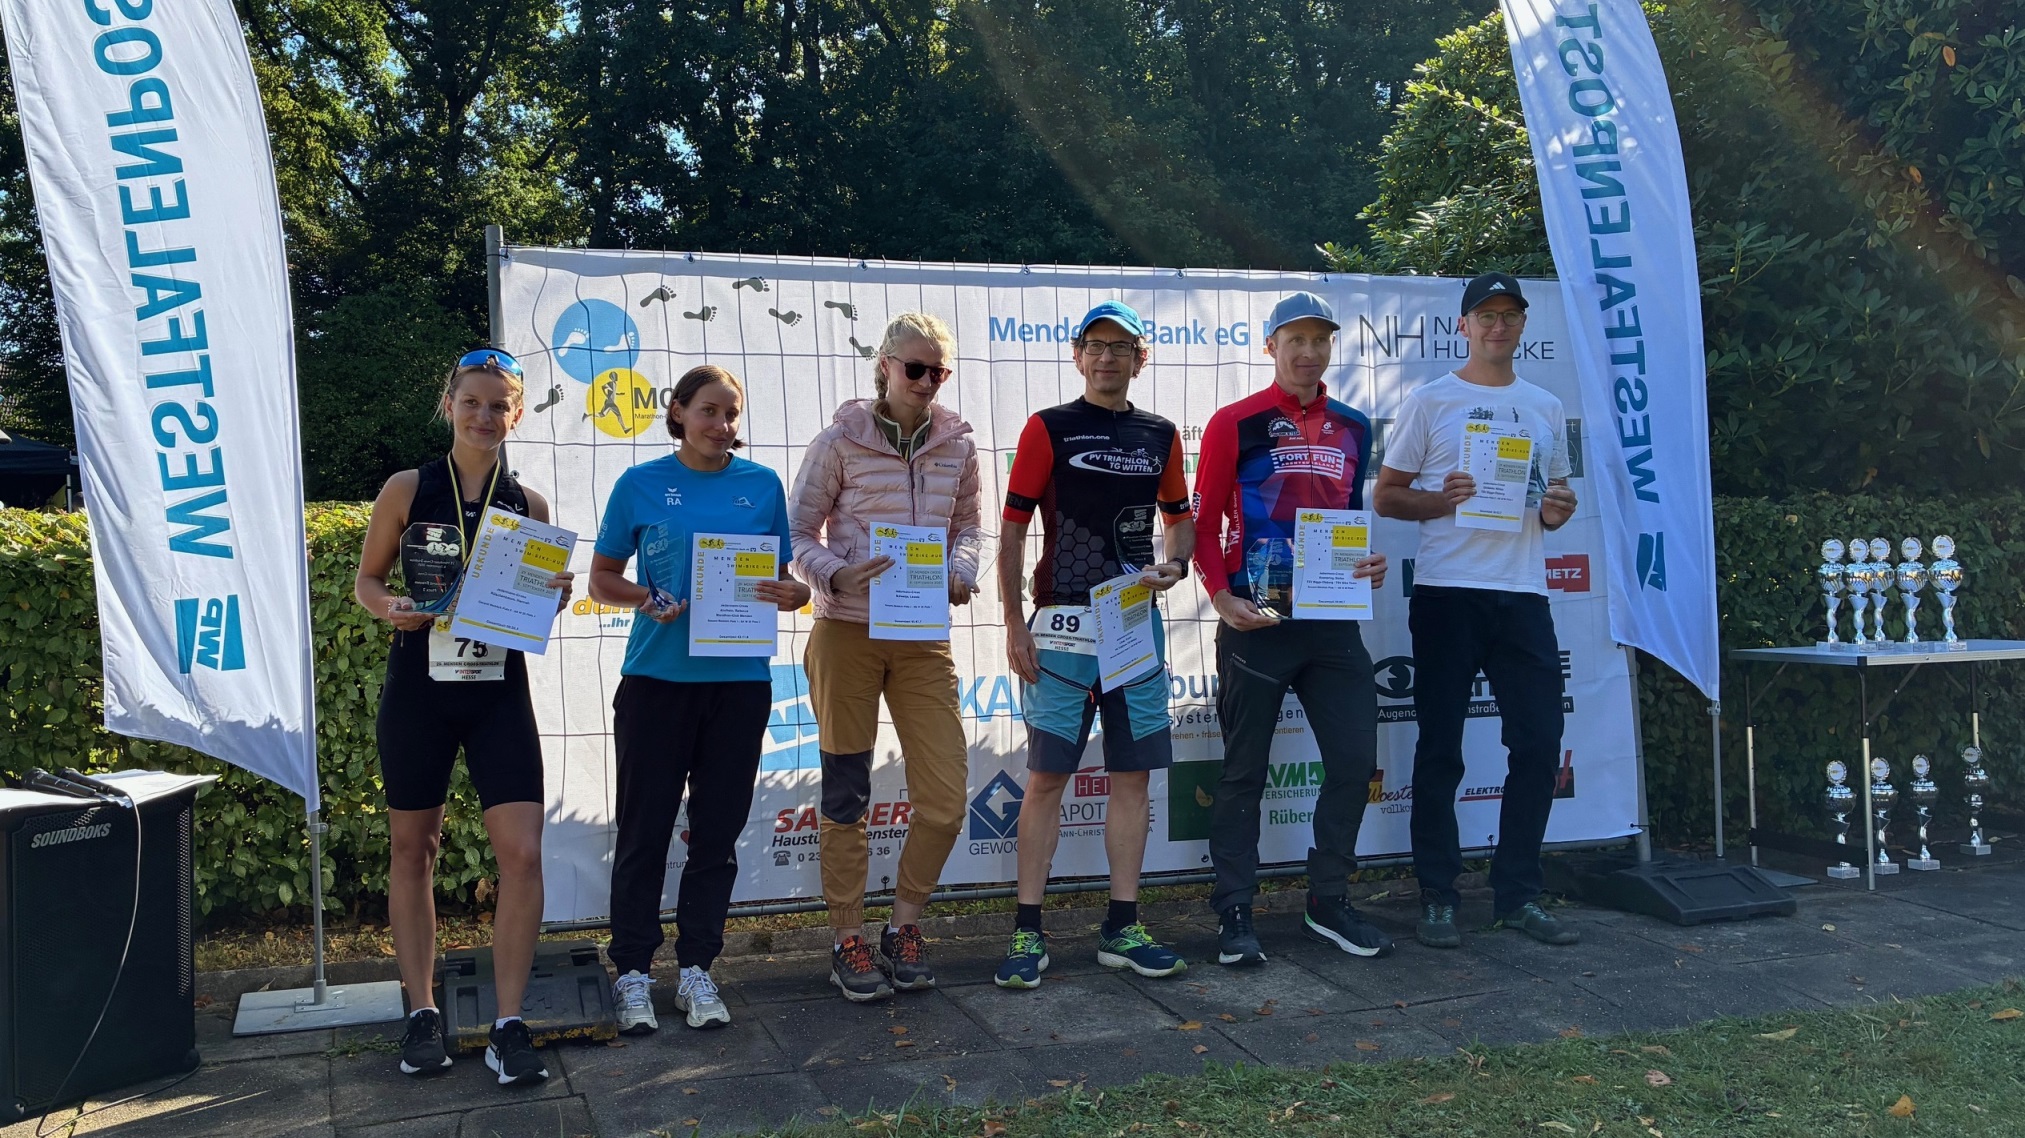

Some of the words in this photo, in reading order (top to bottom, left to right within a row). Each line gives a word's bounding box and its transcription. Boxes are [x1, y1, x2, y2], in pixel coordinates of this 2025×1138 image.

[989, 315, 1081, 343] Mende
[1144, 318, 1208, 345] Bank
[1214, 321, 1250, 347] eG
[1359, 314, 1425, 359] NH
[1089, 453, 1102, 461] PV
[1103, 454, 1149, 466] TRIATHLON
[1279, 452, 1310, 462] FORT
[1312, 453, 1336, 464] FUN
[1463, 434, 1472, 473] RKUNDE
[1109, 461, 1121, 470] TG
[1122, 463, 1153, 473] WITTEN
[667, 497, 682, 506] RA
[502, 536, 542, 552] MENDEN
[471, 527, 495, 579] URKUNDE
[695, 551, 705, 601] URKUNDE
[1050, 613, 1080, 633] 89
[455, 637, 489, 659] 75
[1171, 731, 1194, 740] rehen
[1275, 726, 1305, 735] ontieren
[1078, 781, 1109, 795] HEI
[1269, 808, 1314, 825] Rüber
[1380, 803, 1412, 815] vollko
[774, 801, 912, 834] SAER
[30, 822, 112, 849] SOUNDBOKS
[866, 827, 909, 841] enster
[1059, 828, 1105, 839] ANN-CHRIST
[797, 853, 805, 862] 0
[876, 846, 890, 856] 36
